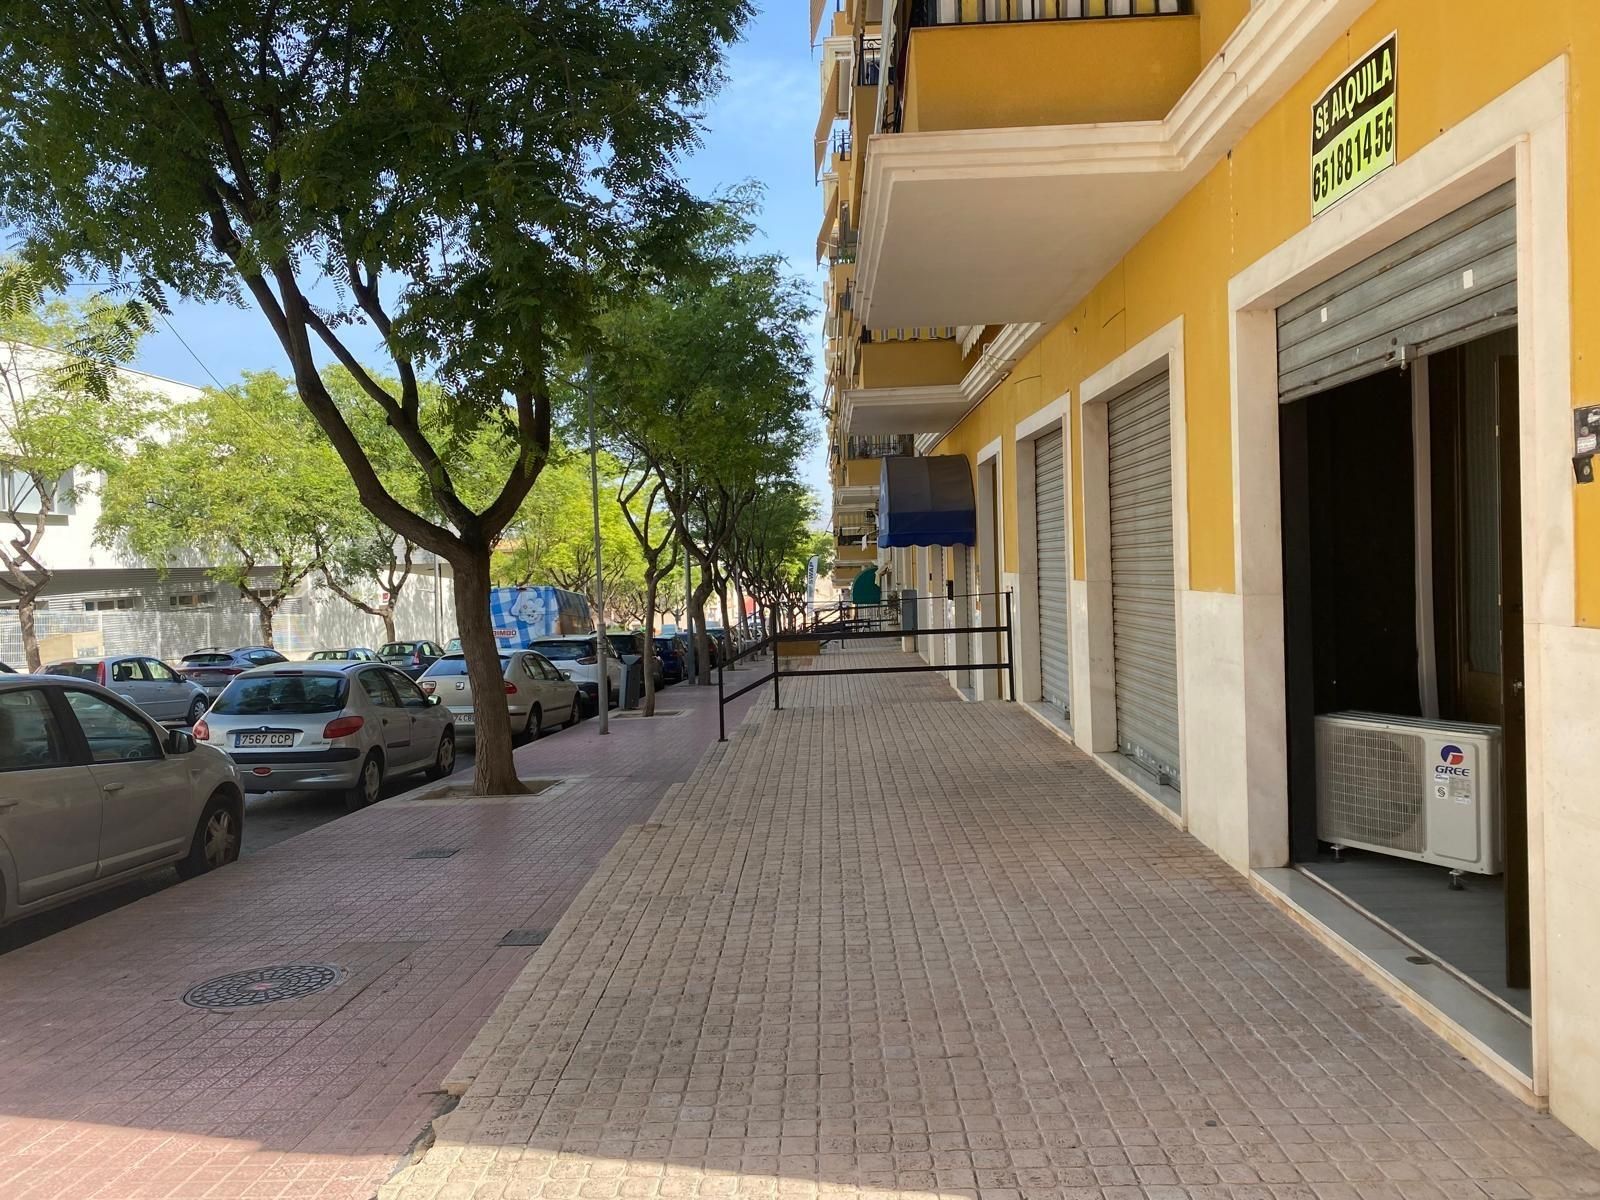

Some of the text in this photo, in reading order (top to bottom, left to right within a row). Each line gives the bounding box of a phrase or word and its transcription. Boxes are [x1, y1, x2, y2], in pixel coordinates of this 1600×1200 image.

[1315, 48, 1393, 140] SE ALQUILA
[1313, 106, 1394, 202] 651881456
[241, 734, 291, 745] 7567 CCP
[1435, 764, 1471, 777] GREE
